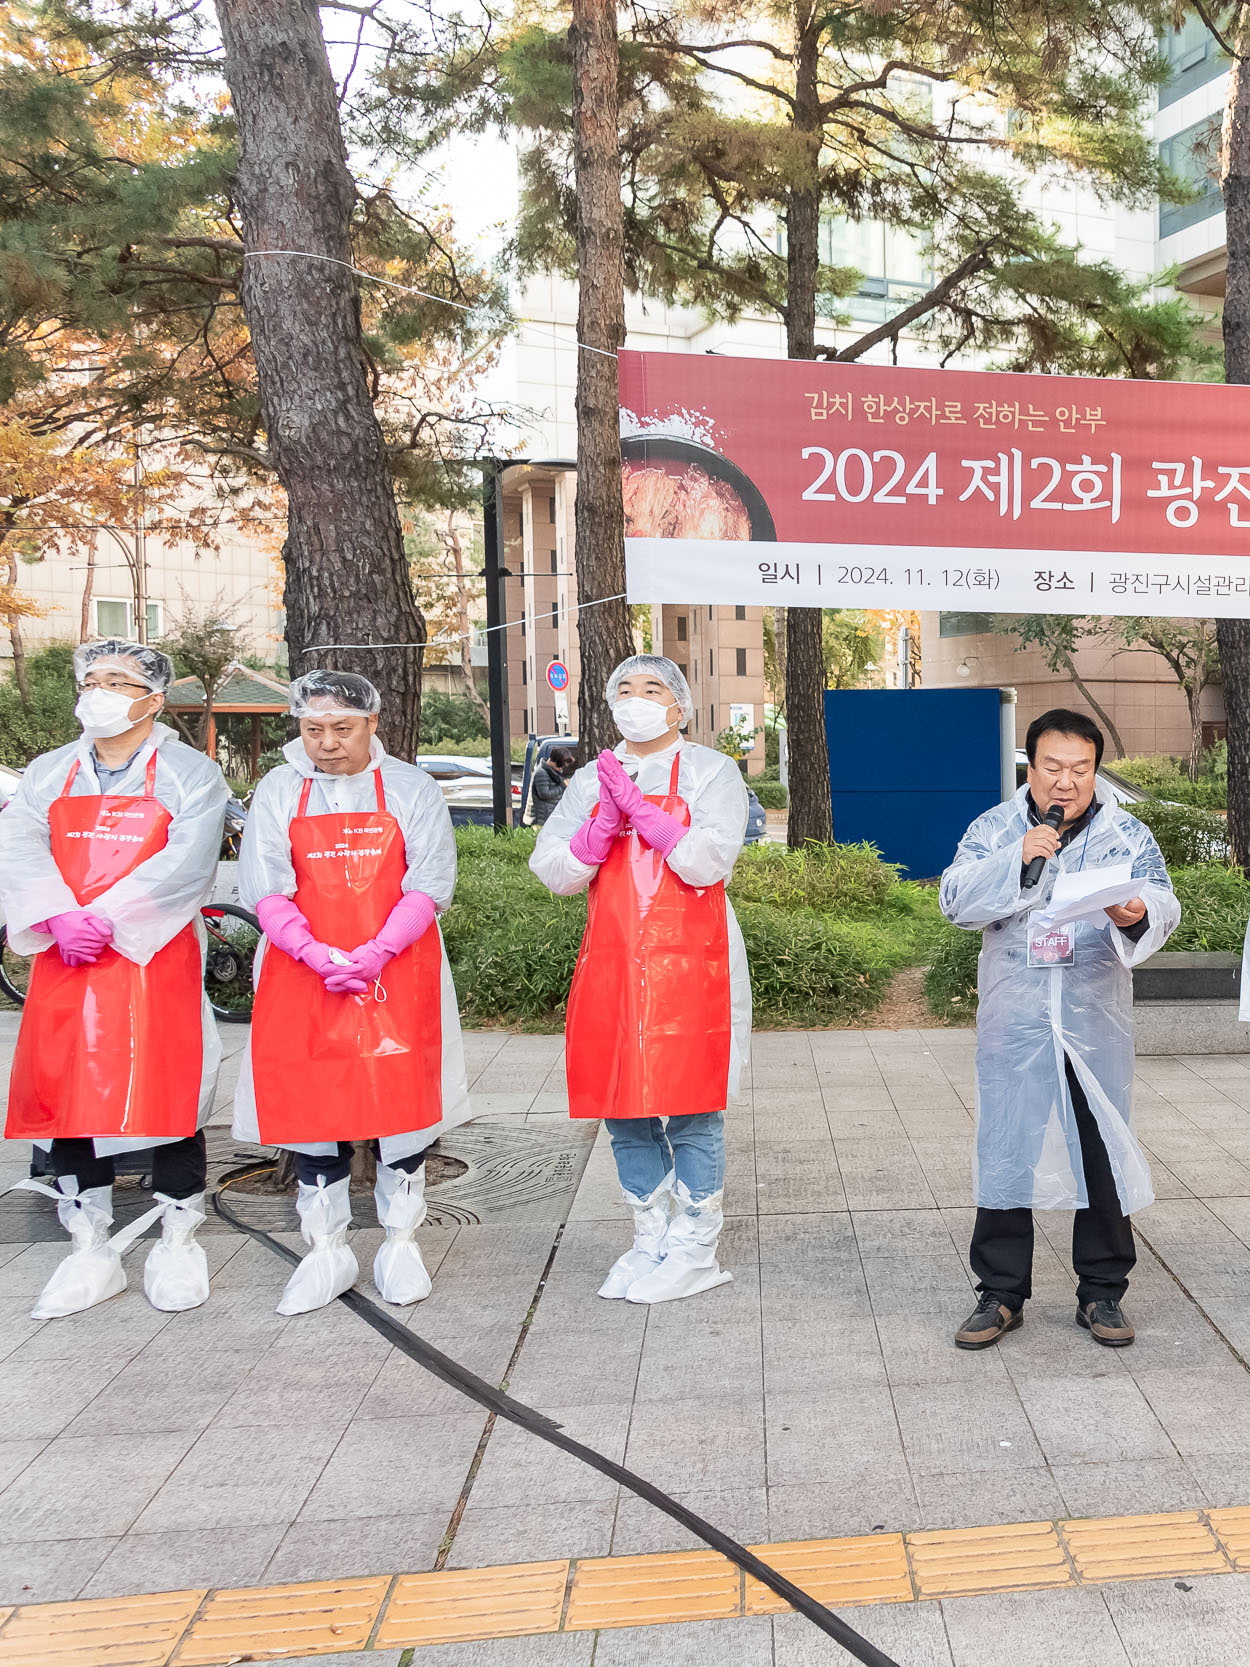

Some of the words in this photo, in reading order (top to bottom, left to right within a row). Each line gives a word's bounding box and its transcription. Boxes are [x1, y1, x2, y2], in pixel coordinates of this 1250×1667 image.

[804, 390, 853, 422] 김치
[860, 393, 968, 426] 한상자로
[972, 400, 1050, 432] 전하는
[1055, 404, 1107, 434] 안부
[801, 446, 944, 505] 2024
[958, 447, 1121, 524] 제2회
[758, 562, 801, 585] 일시
[837, 566, 893, 585] 2024.
[904, 568, 931, 586] 11.
[941, 568, 1000, 591] 12(화)
[1033, 570, 1076, 592] 장소
[1035, 937, 1068, 947] STAFF
